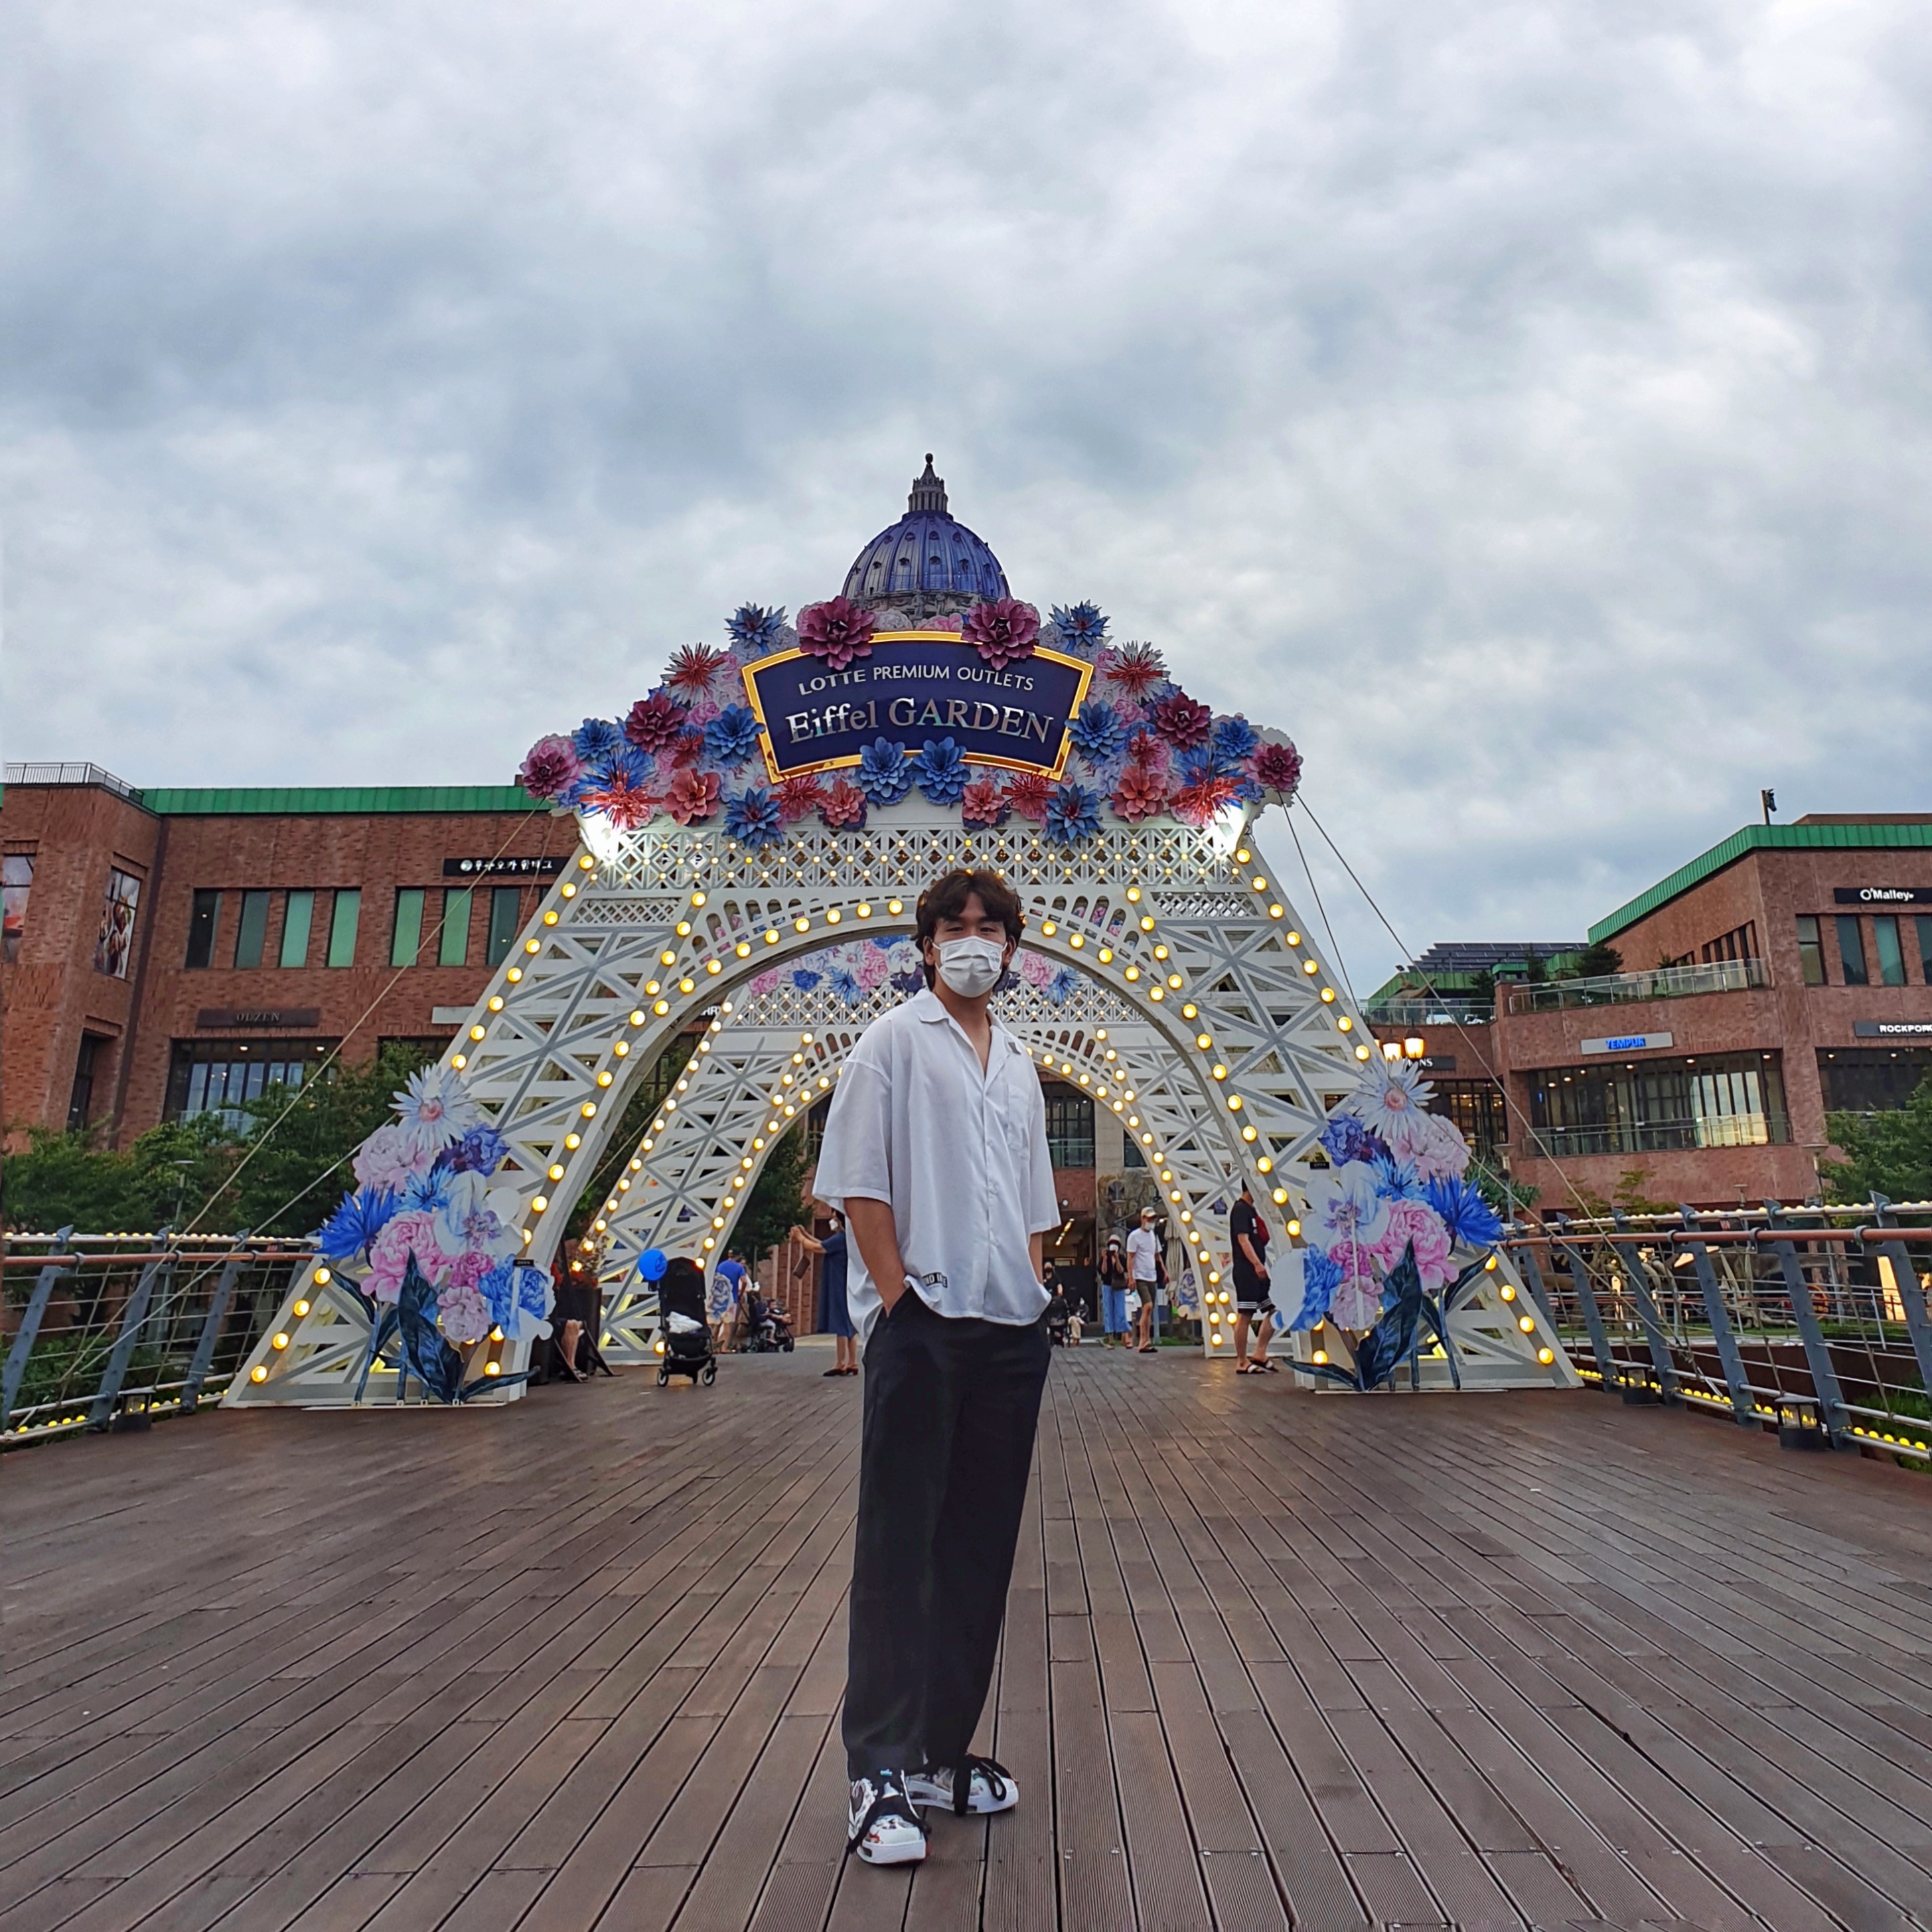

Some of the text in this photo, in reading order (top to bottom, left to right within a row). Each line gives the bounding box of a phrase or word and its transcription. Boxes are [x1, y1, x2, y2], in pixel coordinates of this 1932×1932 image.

[798, 665, 1033, 696] LOTTE PREMIUM OUTLETS
[785, 698, 1054, 743] Eiffel GARDEN
[236, 1012, 280, 1022] OLZEN
[1606, 1037, 1646, 1049] TEMPUR
